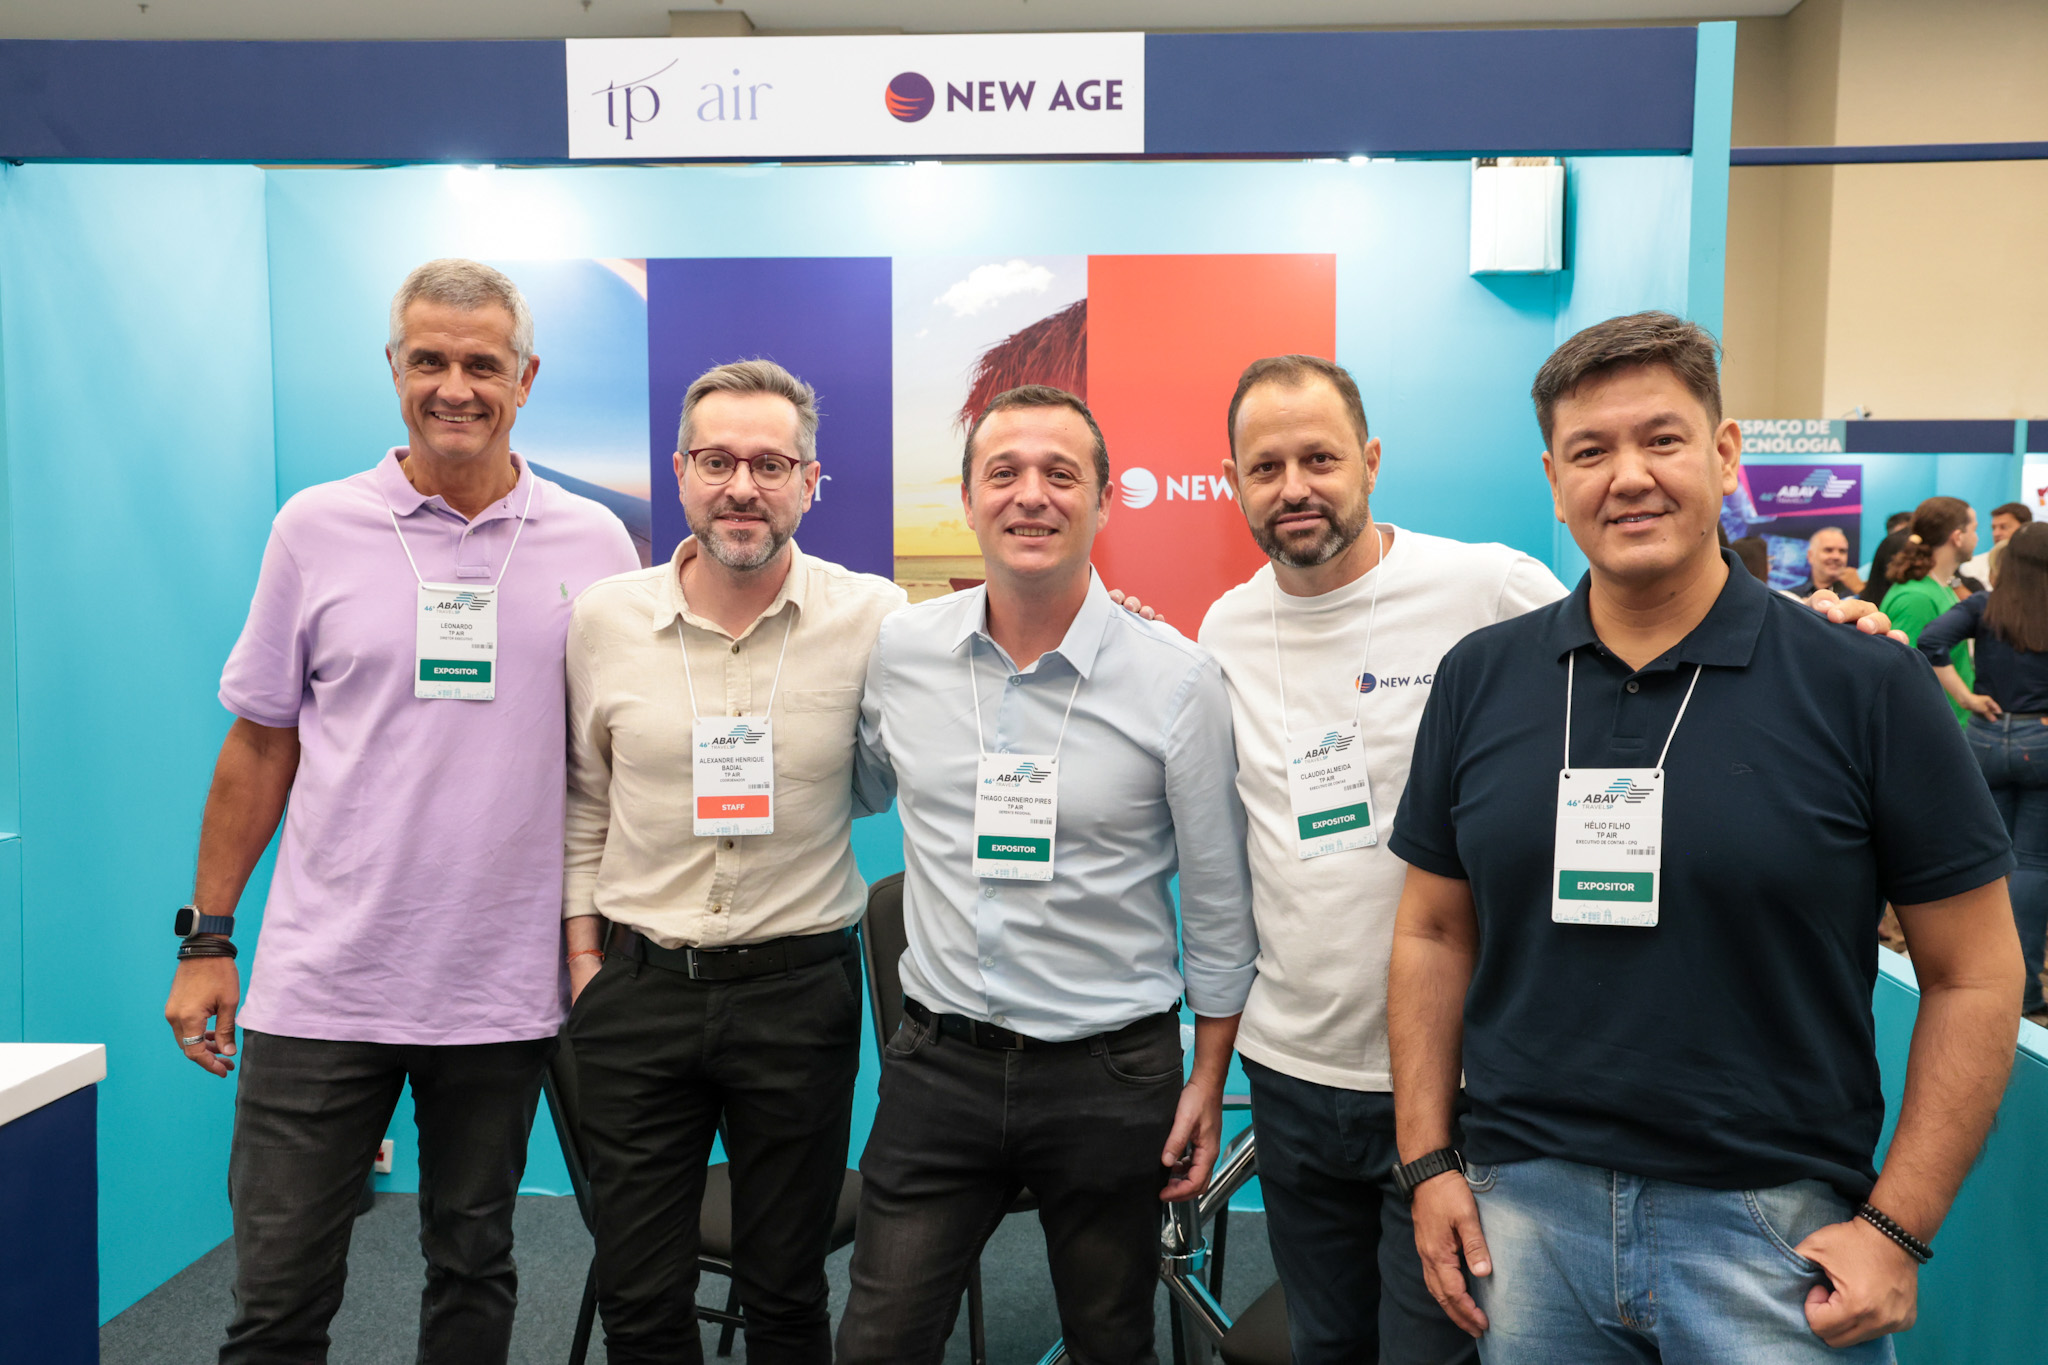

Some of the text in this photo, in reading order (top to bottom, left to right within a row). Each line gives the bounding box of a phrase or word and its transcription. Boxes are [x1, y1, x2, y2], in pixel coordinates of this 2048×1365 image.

[592, 58, 774, 140] tp air
[946, 79, 1124, 113] NEW AGE
[1805, 420, 1831, 435] DE
[1166, 475, 1234, 501] NEW
[436, 602, 464, 610] ABAV
[434, 667, 478, 675] EXPOSITOR
[1380, 674, 1435, 688] NEW AG
[1305, 746, 1331, 759] ABAV
[997, 774, 1024, 782] ABAV
[1300, 763, 1352, 780] CLAUDIO ALMEIDA
[1583, 794, 1619, 804] ABAV
[1312, 814, 1356, 830] EXPOSITOR
[1584, 821, 1606, 830] HÉLIO
[991, 844, 1036, 853] EXPOSITOR
[1577, 882, 1635, 892] EXPOSITOR
